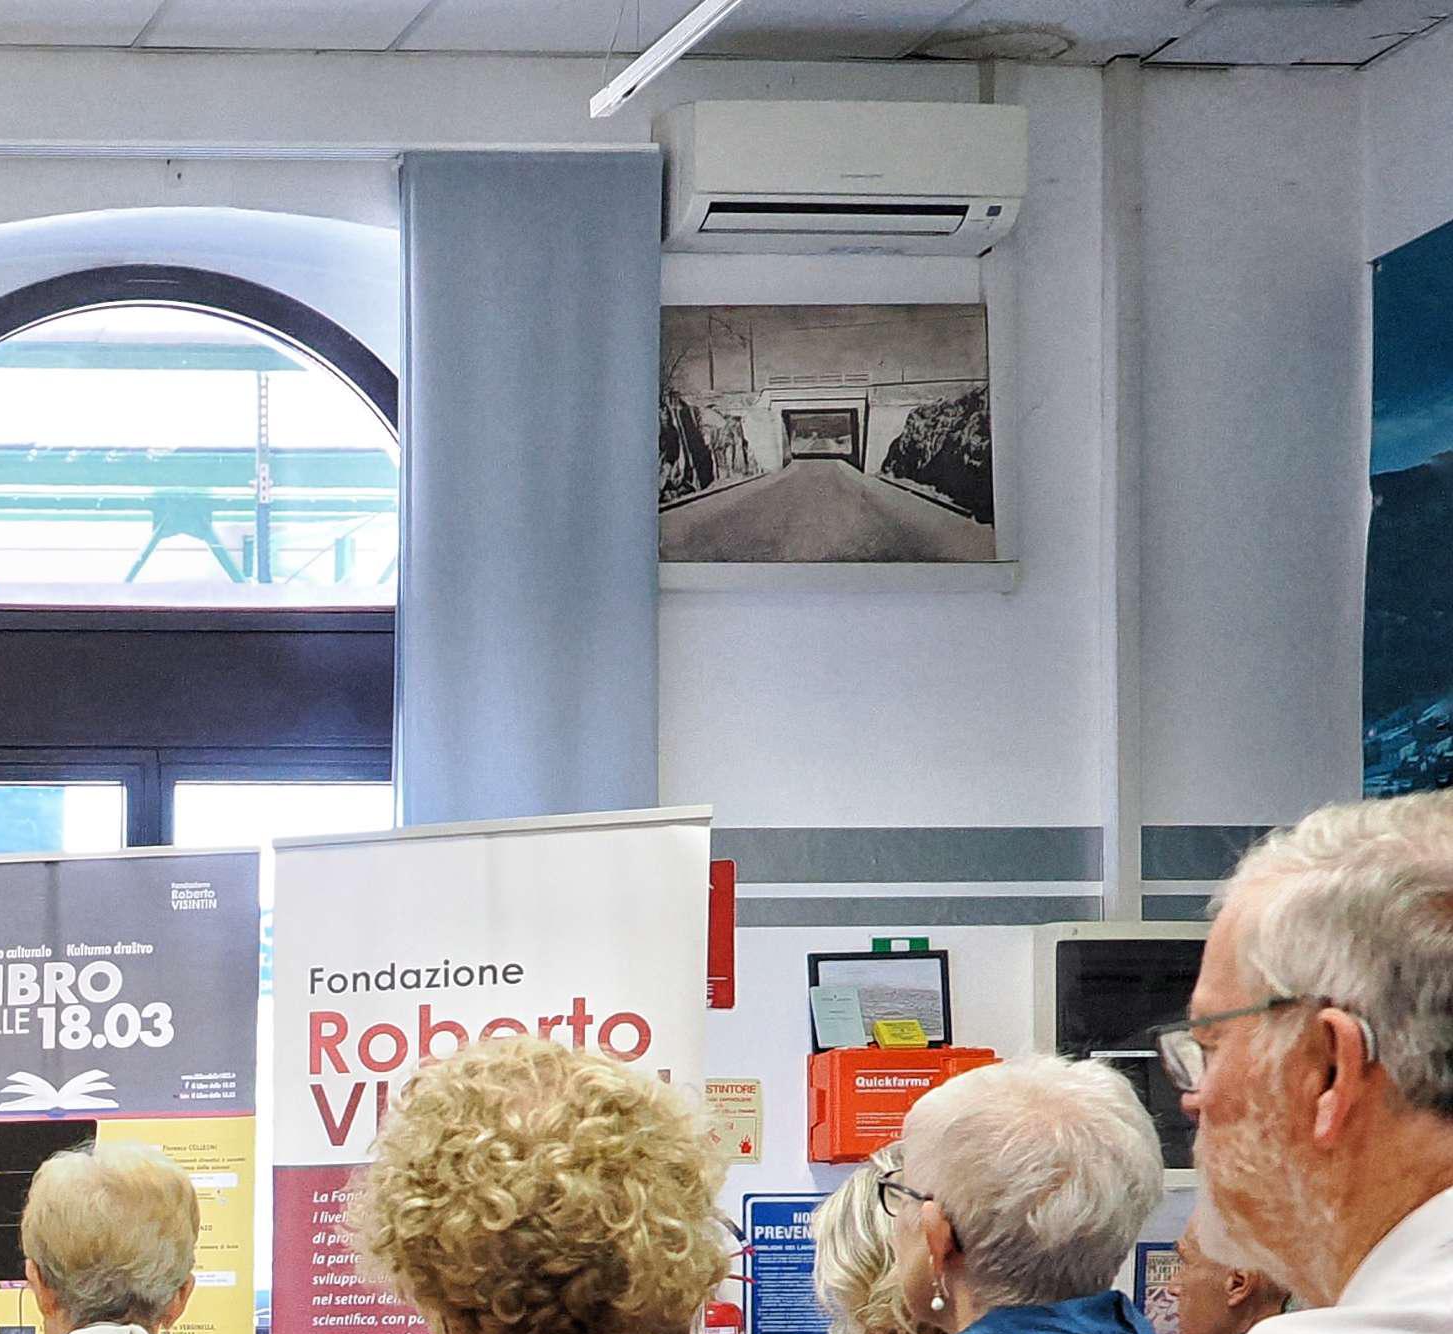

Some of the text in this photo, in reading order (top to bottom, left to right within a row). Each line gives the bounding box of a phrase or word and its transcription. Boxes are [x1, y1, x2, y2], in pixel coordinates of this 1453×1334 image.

[172, 889, 215, 899] Roberto
[172, 899, 217, 910] VISINTIN
[6, 945, 52, 959] culturale
[310, 959, 524, 995] Fondazione
[37, 1001, 174, 1050] 18.03
[855, 1076, 930, 1088] Quickfarma
[706, 1085, 757, 1094] STINTORE
[313, 1191, 328, 1203] La
[313, 1232, 326, 1244] di
[754, 1225, 814, 1239] PREVEN
[313, 1252, 325, 1265] la
[334, 1292, 376, 1305] settori
[312, 1313, 378, 1327] scientifica,
[382, 1315, 405, 1325] con
